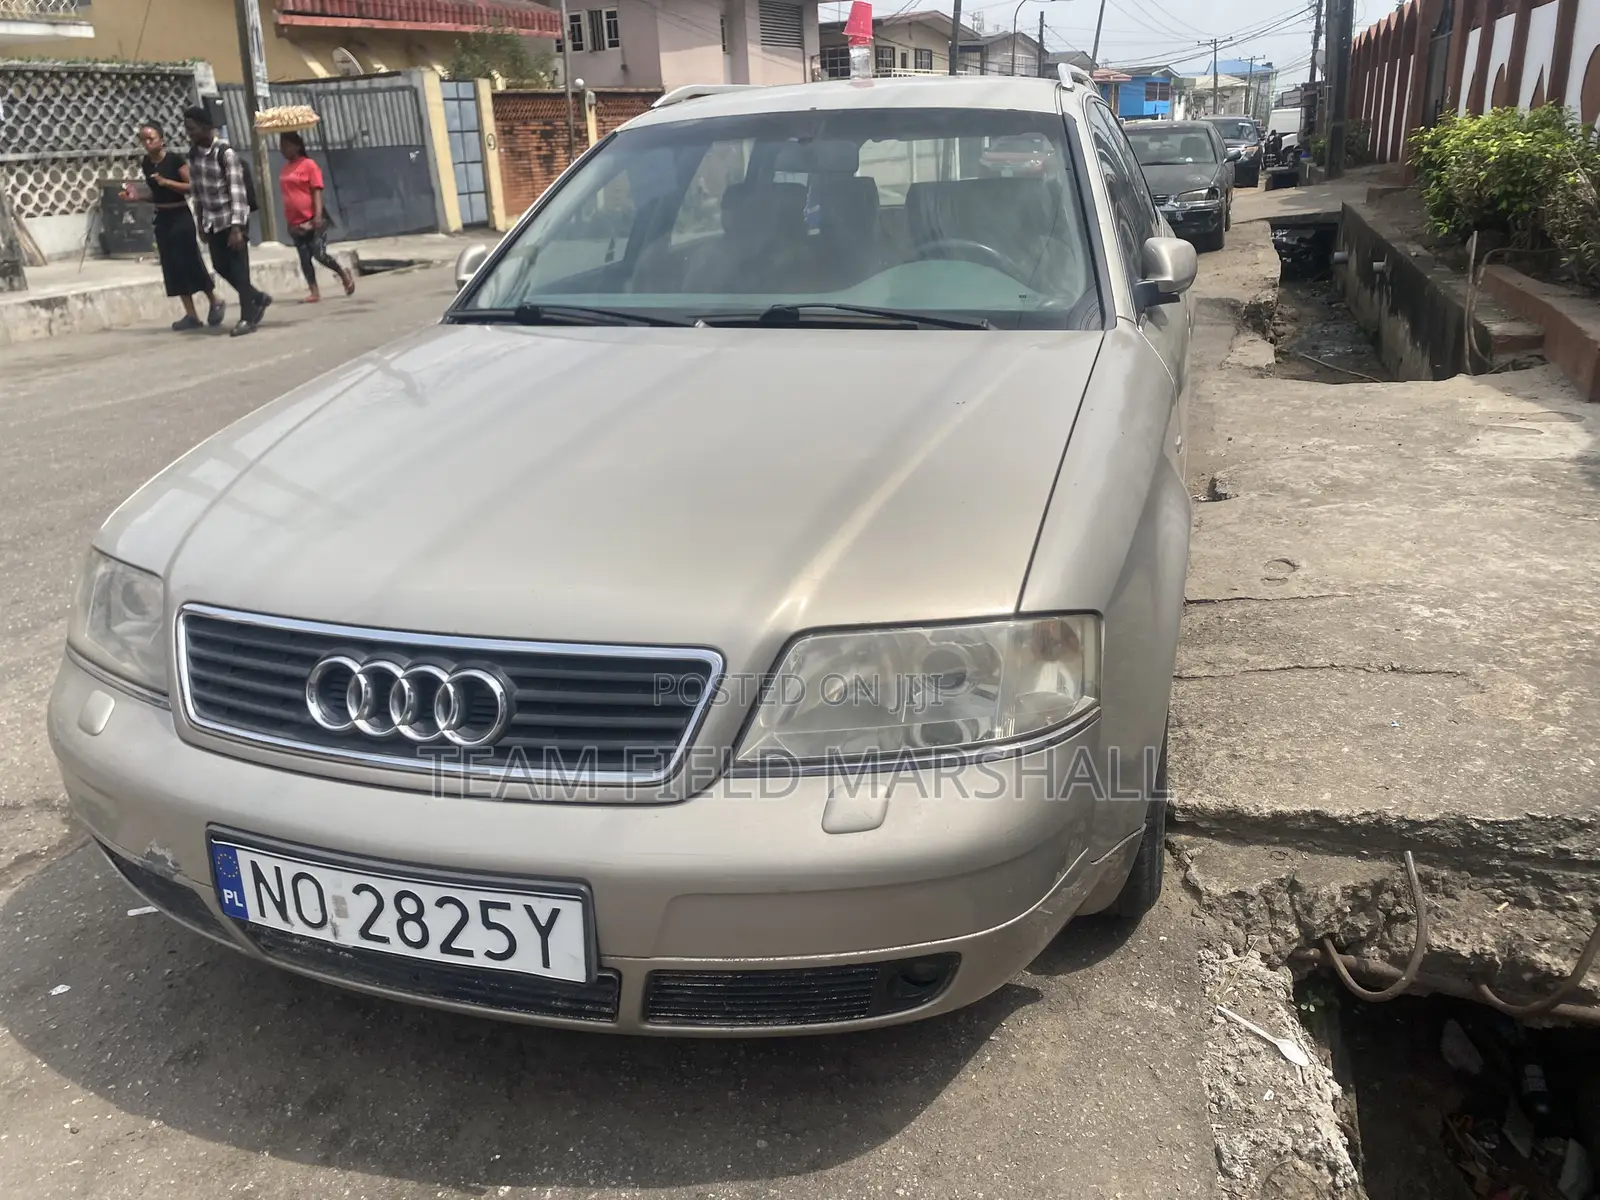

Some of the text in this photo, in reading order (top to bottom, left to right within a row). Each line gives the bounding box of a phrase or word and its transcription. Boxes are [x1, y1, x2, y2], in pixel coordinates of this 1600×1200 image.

[223, 888, 244, 907] PL
[250, 859, 561, 969] NO 2825Y
